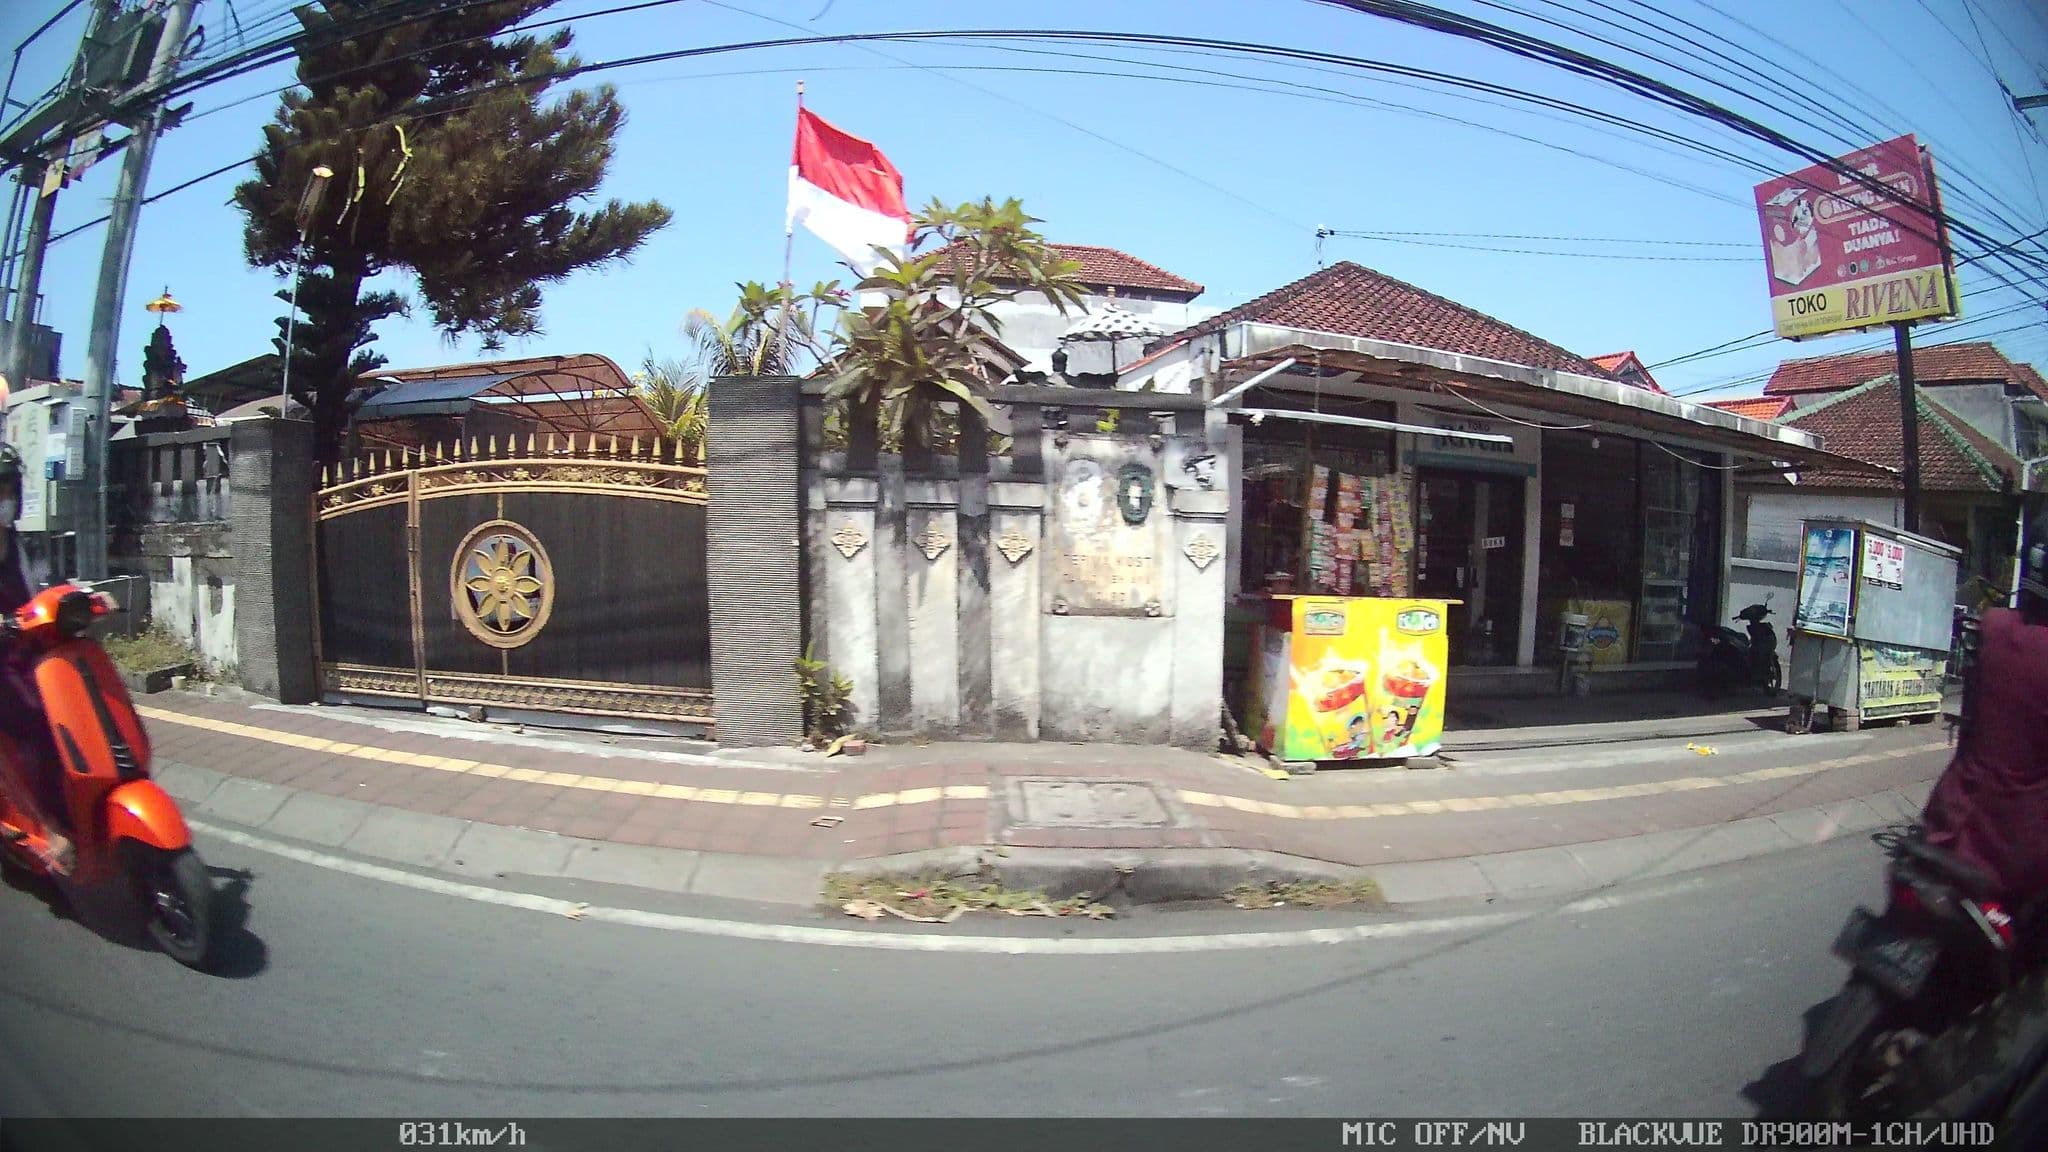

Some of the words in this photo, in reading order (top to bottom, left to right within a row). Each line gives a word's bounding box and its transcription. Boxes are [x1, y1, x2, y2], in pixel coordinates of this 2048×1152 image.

[1848, 217, 1889, 236] TIADA
[1843, 230, 1901, 254] DUANYA!
[1788, 292, 1827, 316] TOKO
[1845, 272, 1940, 321] RIVENA
